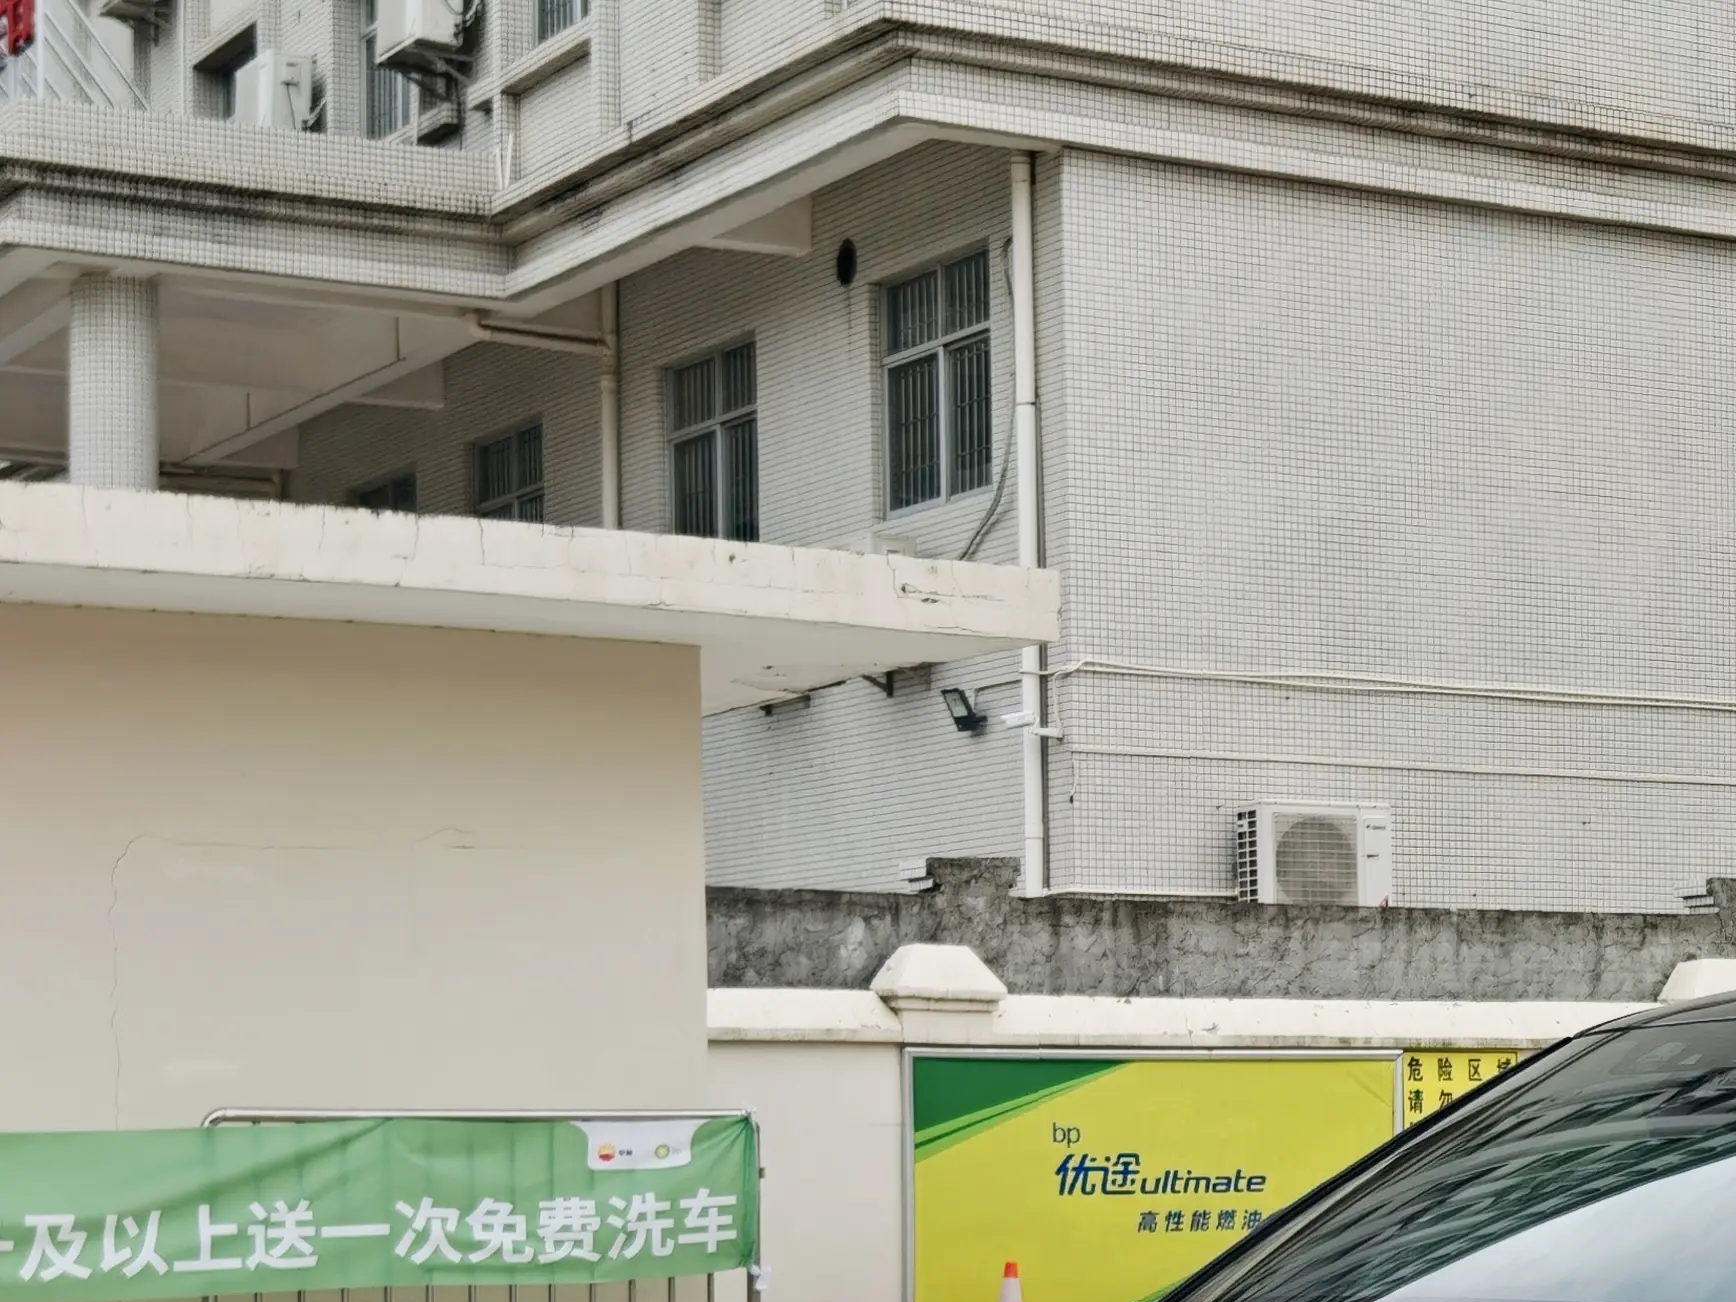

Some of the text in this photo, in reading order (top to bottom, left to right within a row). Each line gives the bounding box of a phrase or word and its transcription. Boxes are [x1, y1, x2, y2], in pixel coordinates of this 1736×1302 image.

[1052, 1122, 1081, 1148] bp
[1140, 1168, 1267, 1195] ultimate
[1138, 1209, 1263, 1233] 高性能燃油
[0, 1187, 738, 1283] 及以上送一次免费洗车
